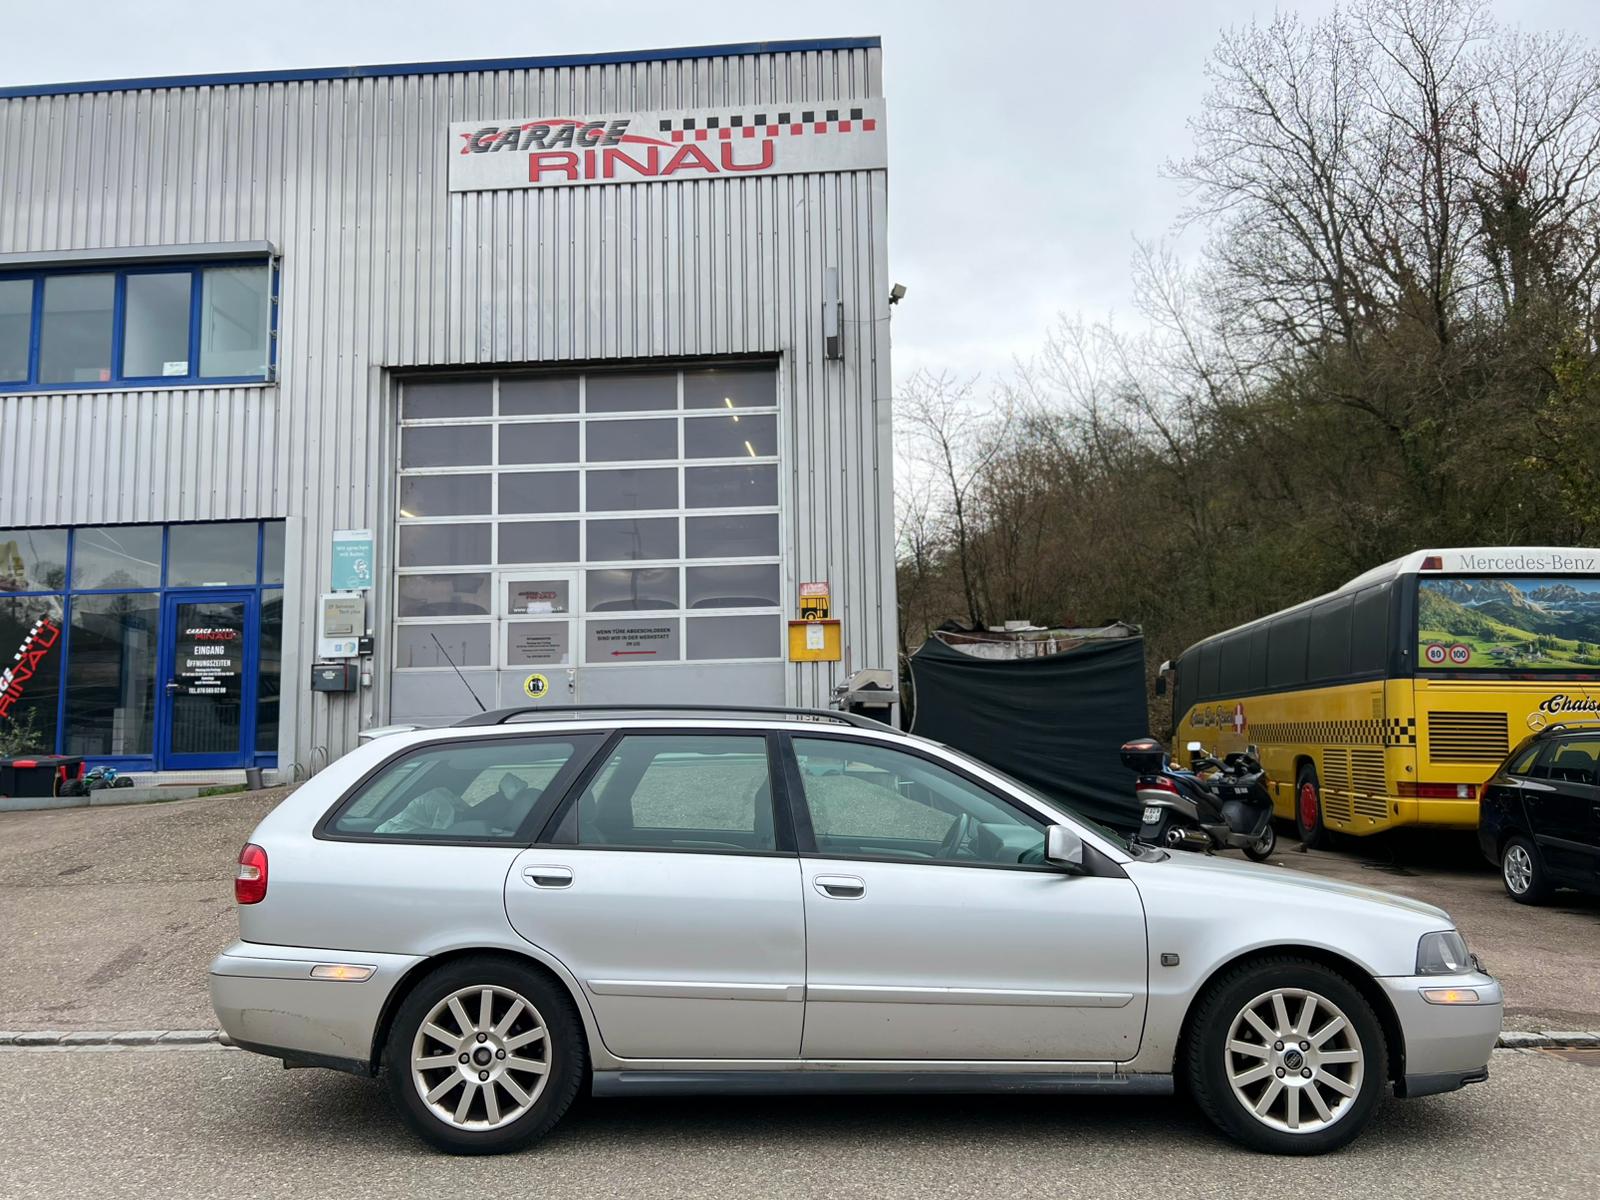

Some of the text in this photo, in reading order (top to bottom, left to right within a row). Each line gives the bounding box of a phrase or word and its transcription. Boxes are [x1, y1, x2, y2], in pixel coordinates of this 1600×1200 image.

[467, 119, 631, 154] GARAGE
[528, 139, 775, 183] RINAU
[1460, 554, 1596, 570] Mercedes-Benz
[194, 645, 225, 655] EINGANG
[1430, 650, 1466, 659] 80 100
[186, 659, 231, 668] ÖFFNUNGSZEITEN
